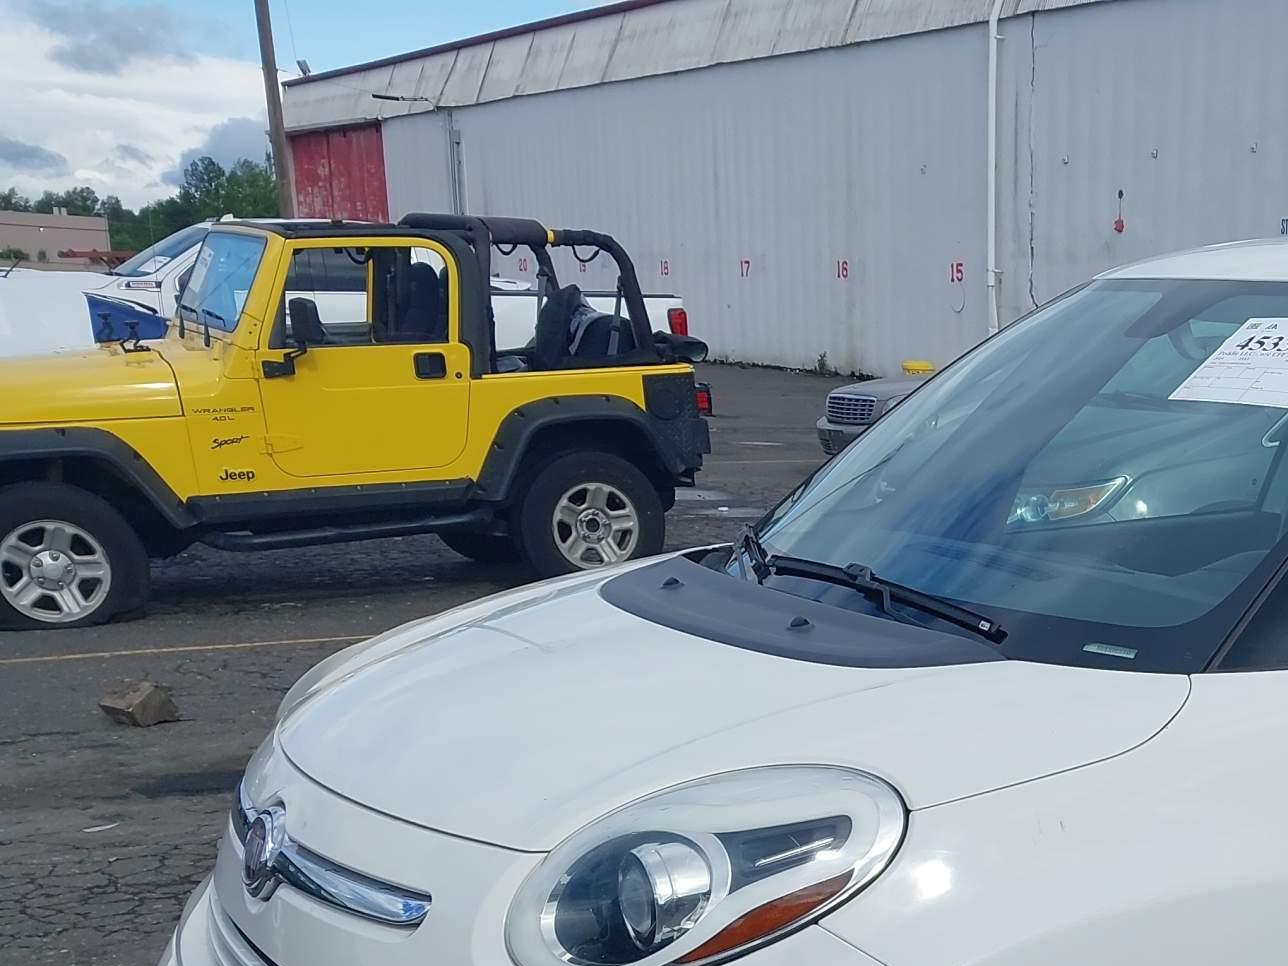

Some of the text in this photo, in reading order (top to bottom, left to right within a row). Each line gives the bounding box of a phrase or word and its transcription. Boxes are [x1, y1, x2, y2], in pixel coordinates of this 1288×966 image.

[660, 260, 669, 275] 18
[740, 260, 750, 277] 17
[837, 260, 848, 278] 16
[951, 263, 963, 282] 15
[219, 468, 255, 481] Jeep
